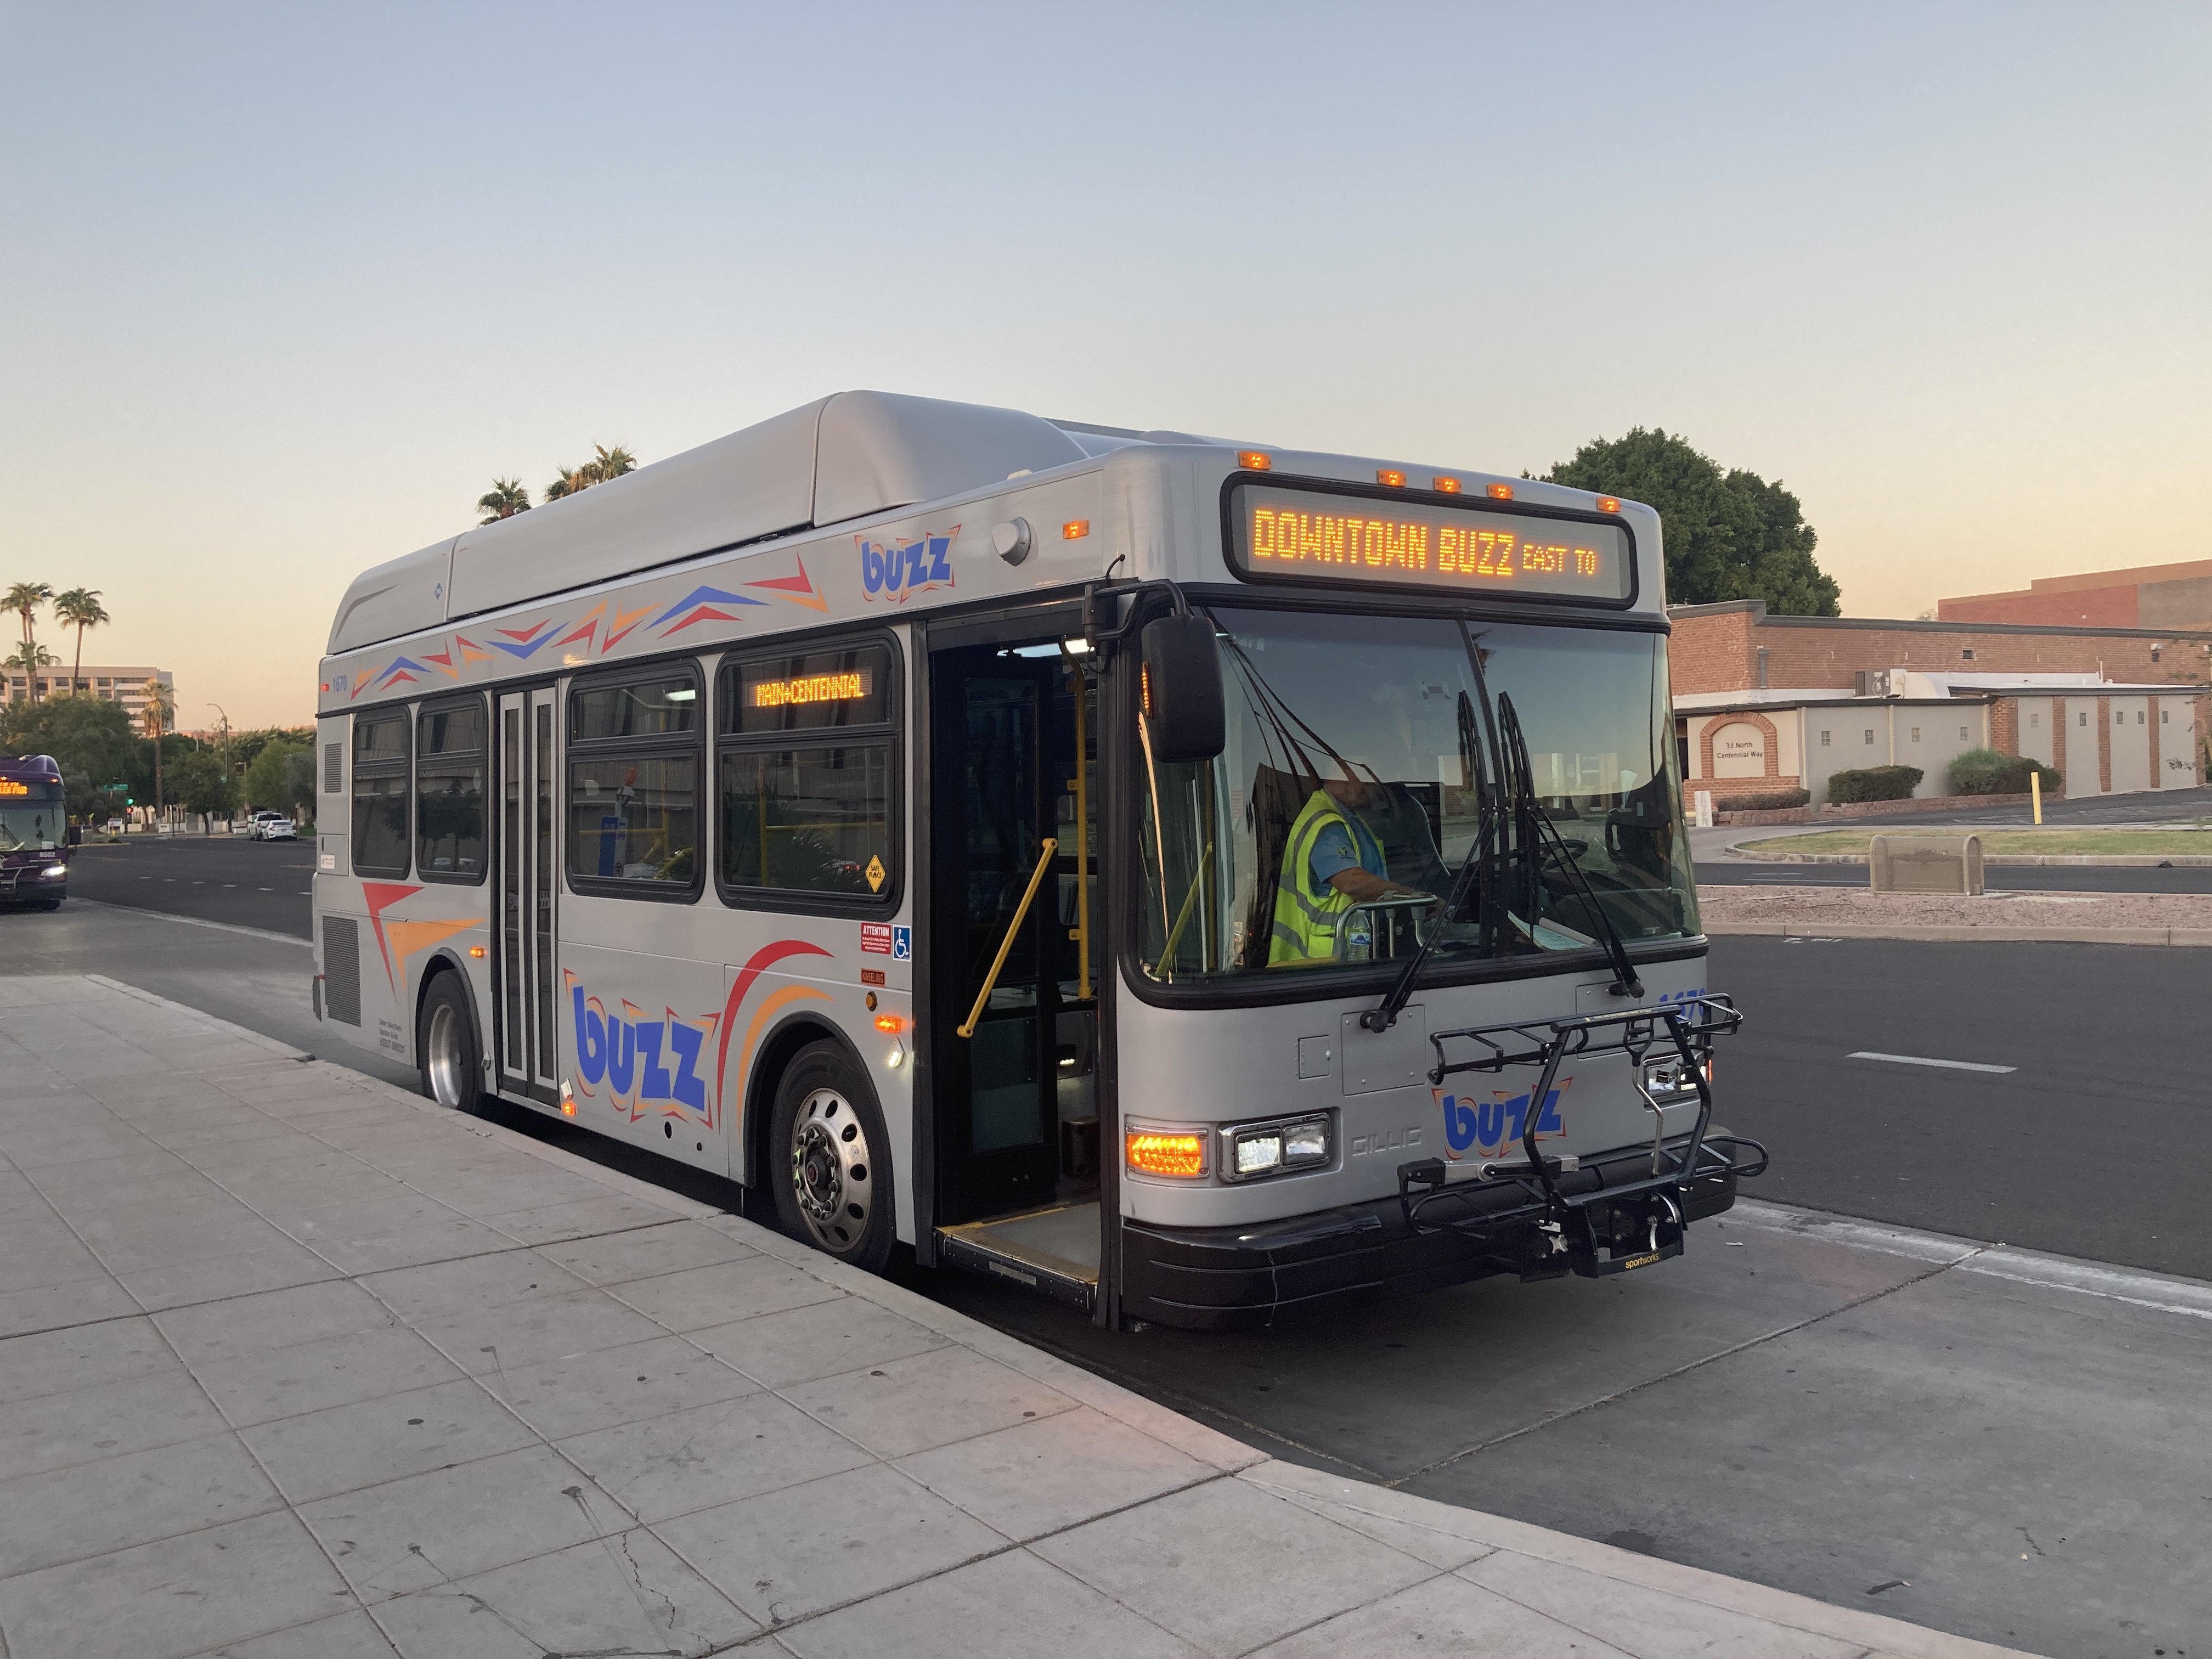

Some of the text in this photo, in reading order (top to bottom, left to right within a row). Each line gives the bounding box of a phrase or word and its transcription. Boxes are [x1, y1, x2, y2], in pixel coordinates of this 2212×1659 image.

[1254, 509, 1595, 575] DOWNTOWN BUZZ EAST TO
[333, 674, 347, 692] 1670
[1700, 792, 1709, 826] ENTER
[863, 925, 889, 937] ATTENTION
[862, 970, 884, 984] KNEELING
[1351, 1126, 1423, 1156] GILLIG
[1625, 1253, 1660, 1269] sportworks
